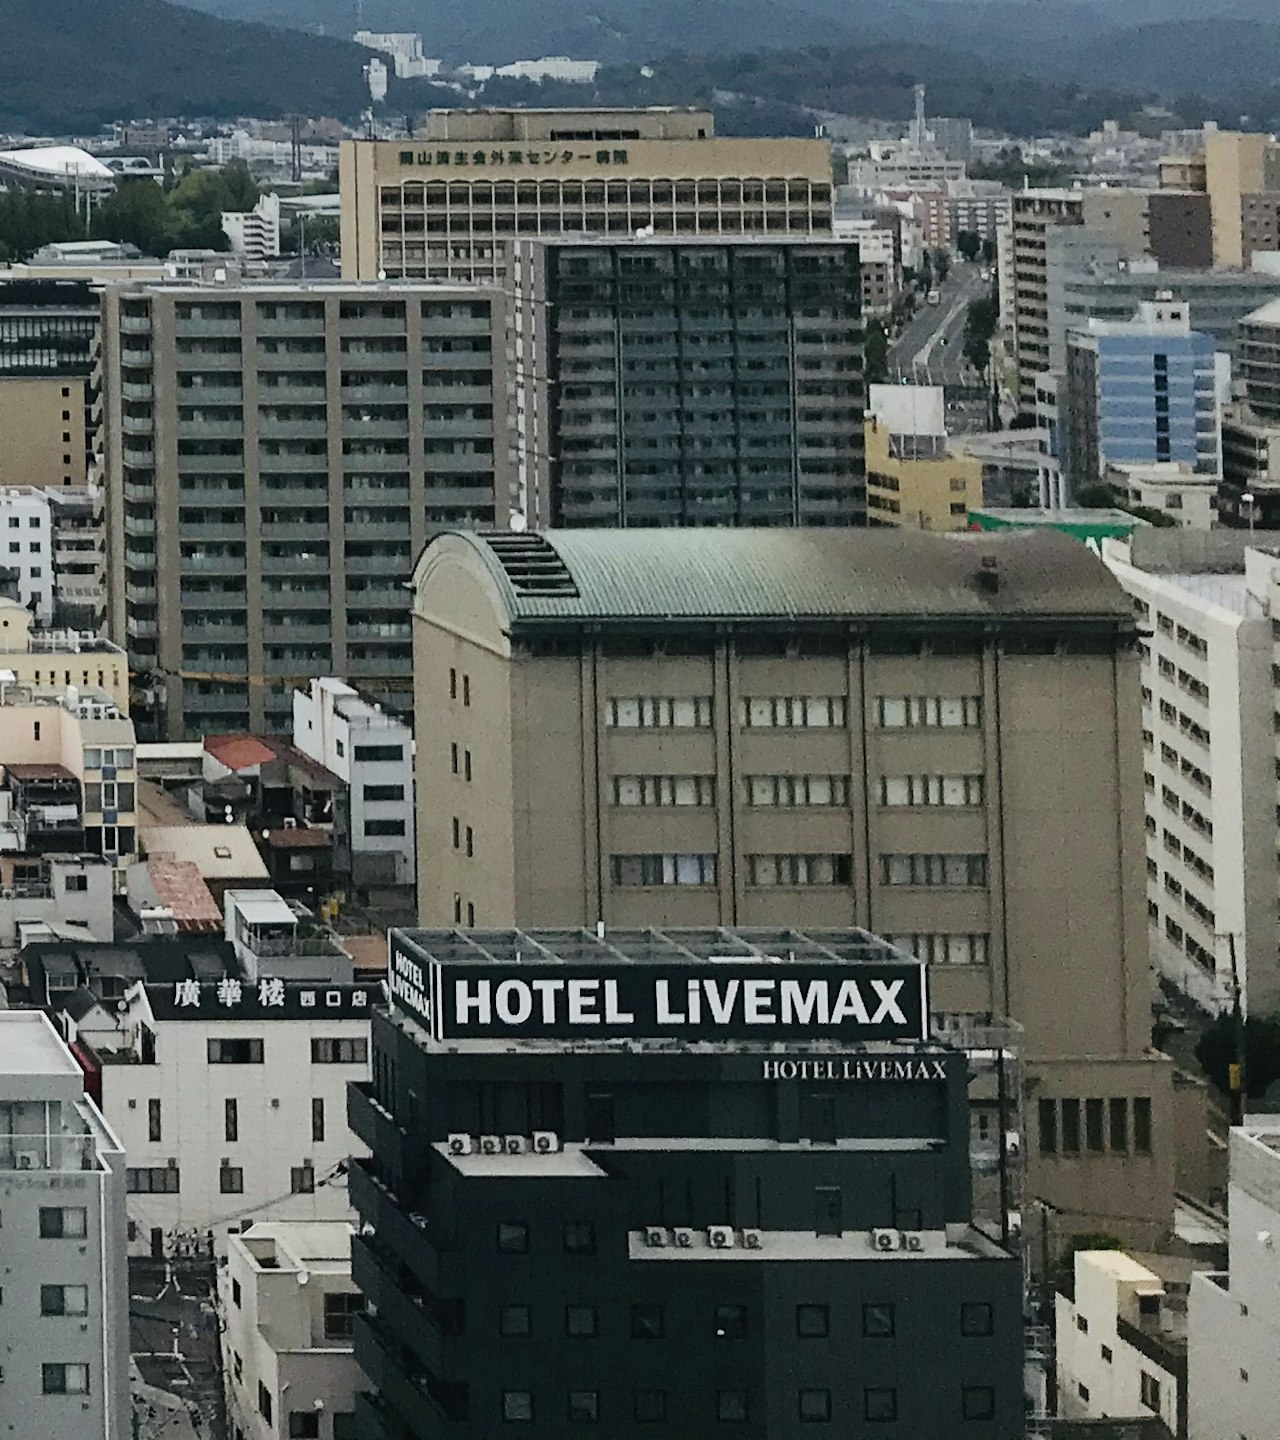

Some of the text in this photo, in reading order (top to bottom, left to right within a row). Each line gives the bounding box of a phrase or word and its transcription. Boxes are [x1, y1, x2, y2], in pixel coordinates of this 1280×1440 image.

[395, 950, 424, 991] HOTEL
[456, 978, 634, 1024] HOTEL
[763, 1060, 839, 1080] HOTEL
